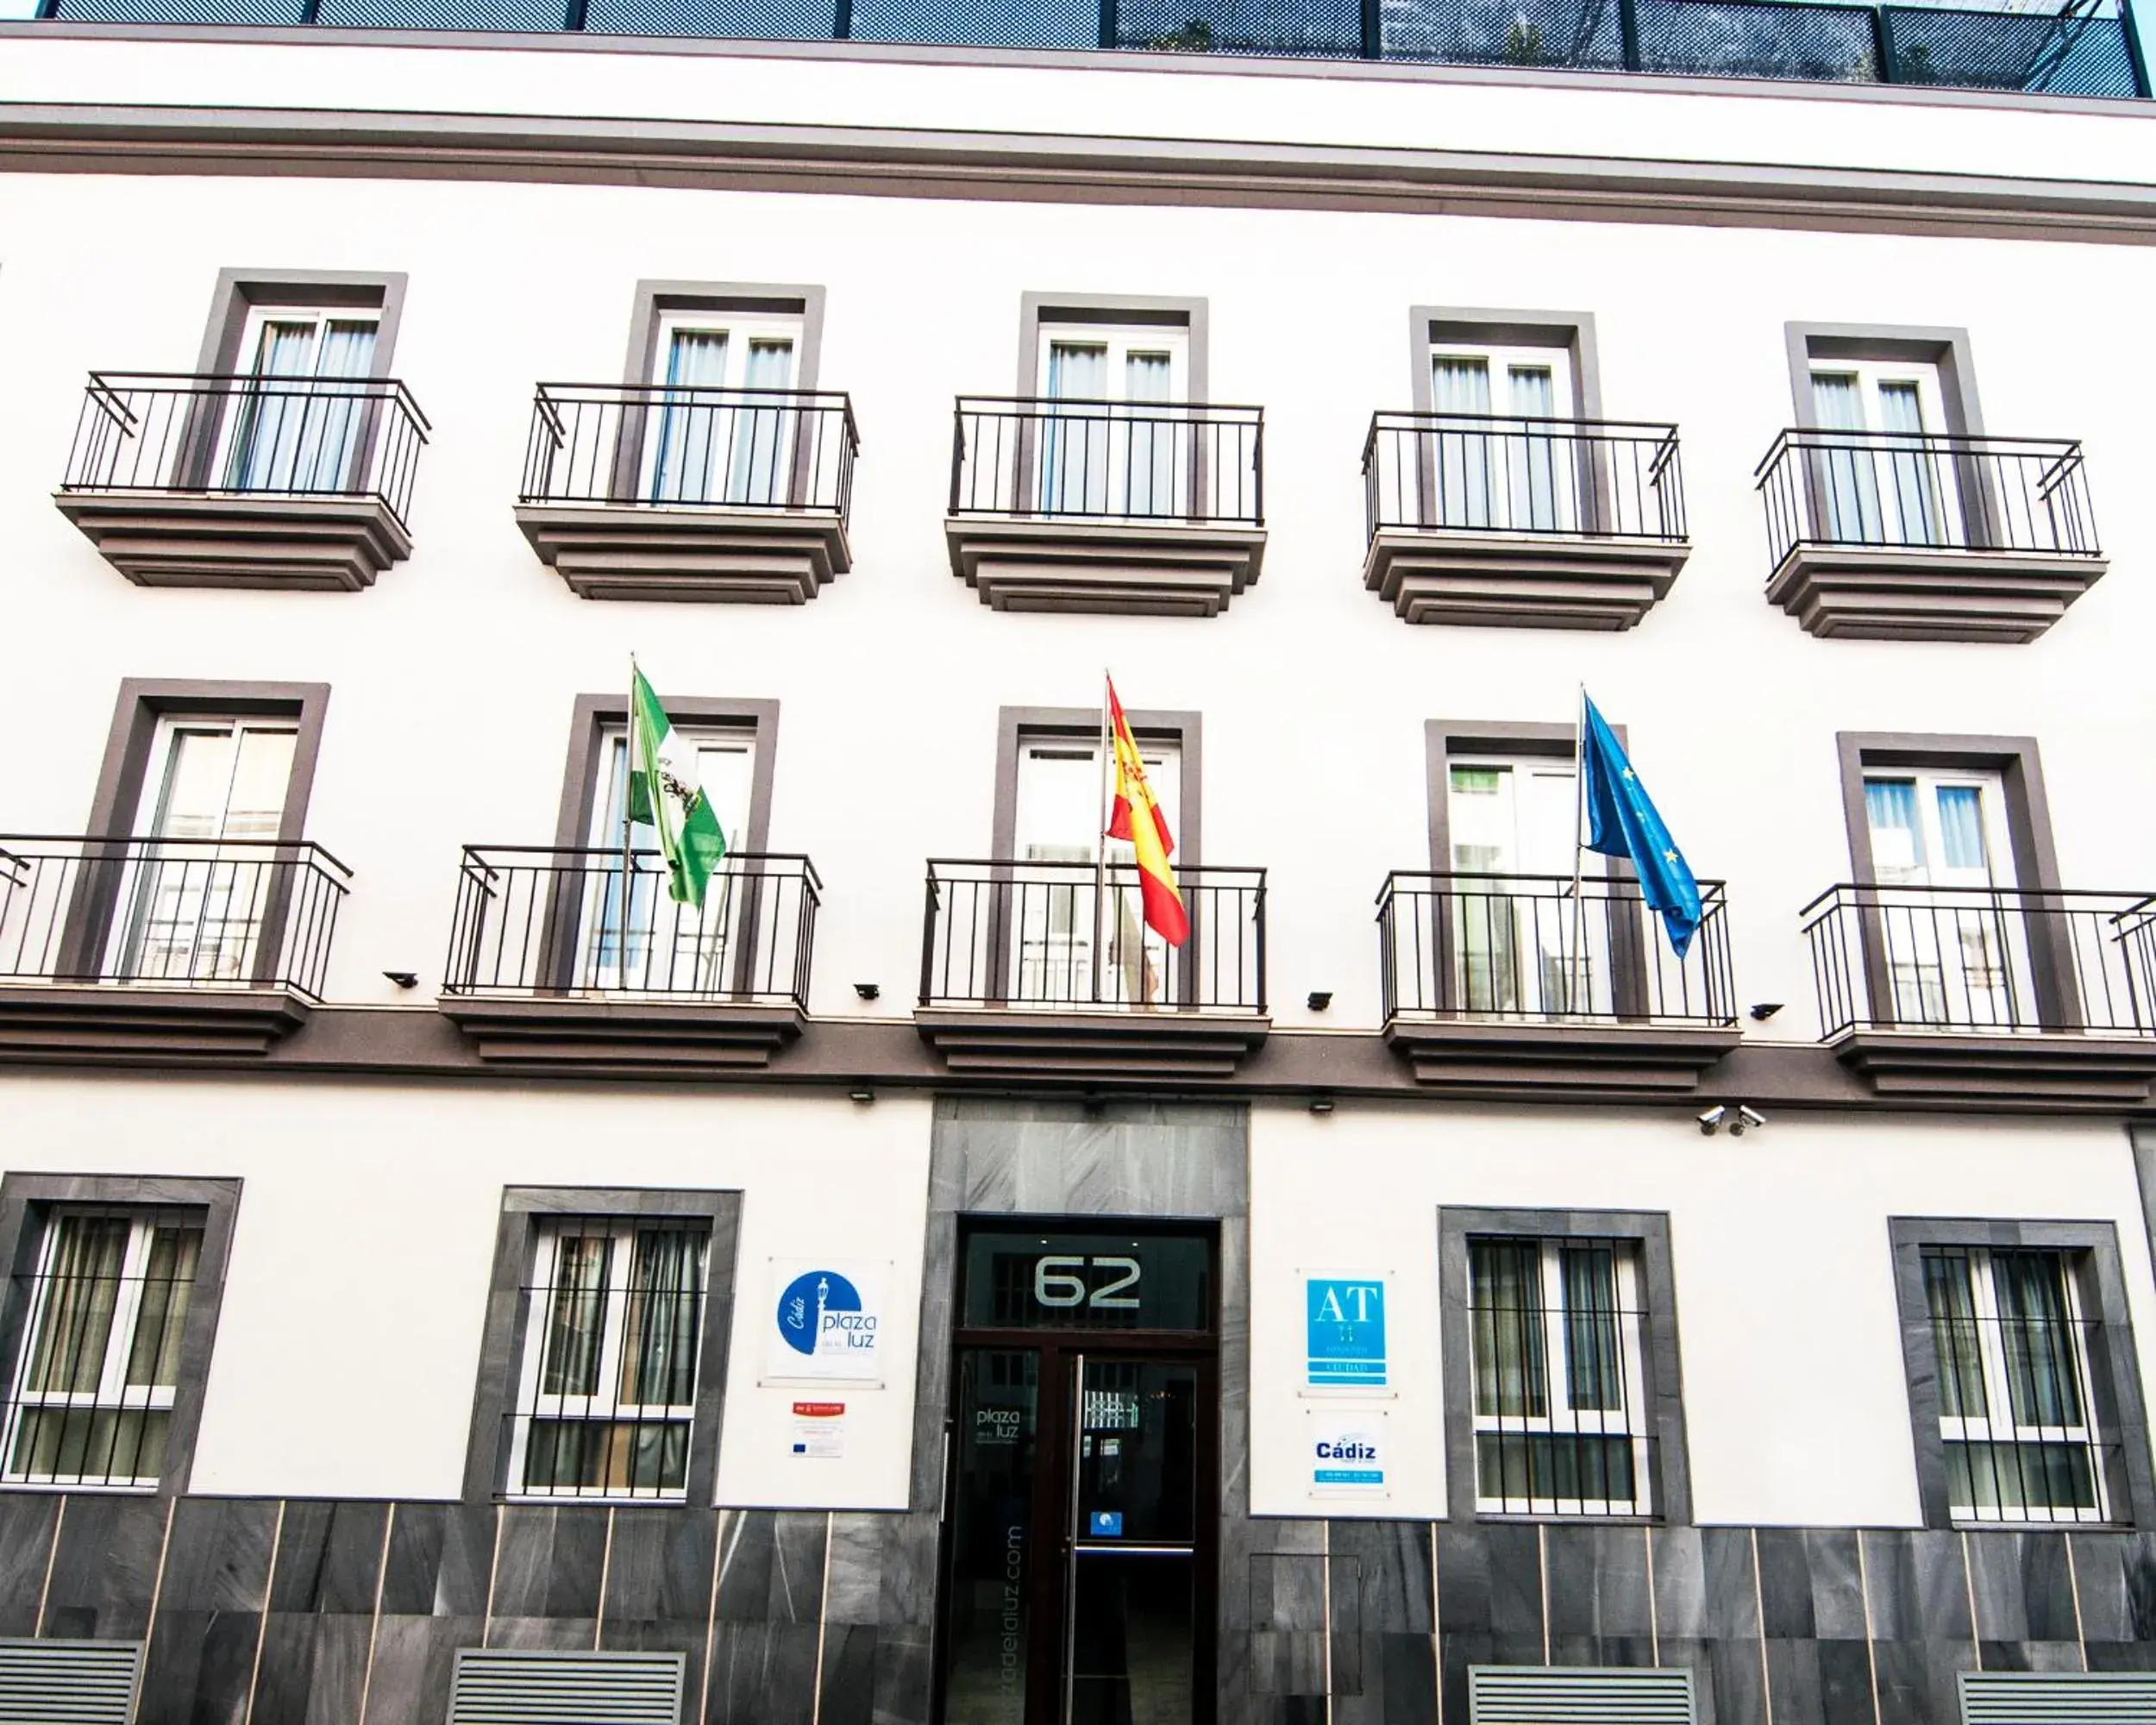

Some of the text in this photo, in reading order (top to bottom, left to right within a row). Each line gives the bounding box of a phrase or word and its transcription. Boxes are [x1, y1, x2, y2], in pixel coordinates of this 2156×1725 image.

[1035, 1256, 1140, 1308] 62
[1313, 1285, 1378, 1322] AT
[823, 1312, 876, 1333] plaza
[847, 1331, 874, 1348] luz
[976, 1408, 1020, 1426] plaza
[996, 1423, 1018, 1438] luz
[1316, 1440, 1376, 1459] Cádiz
